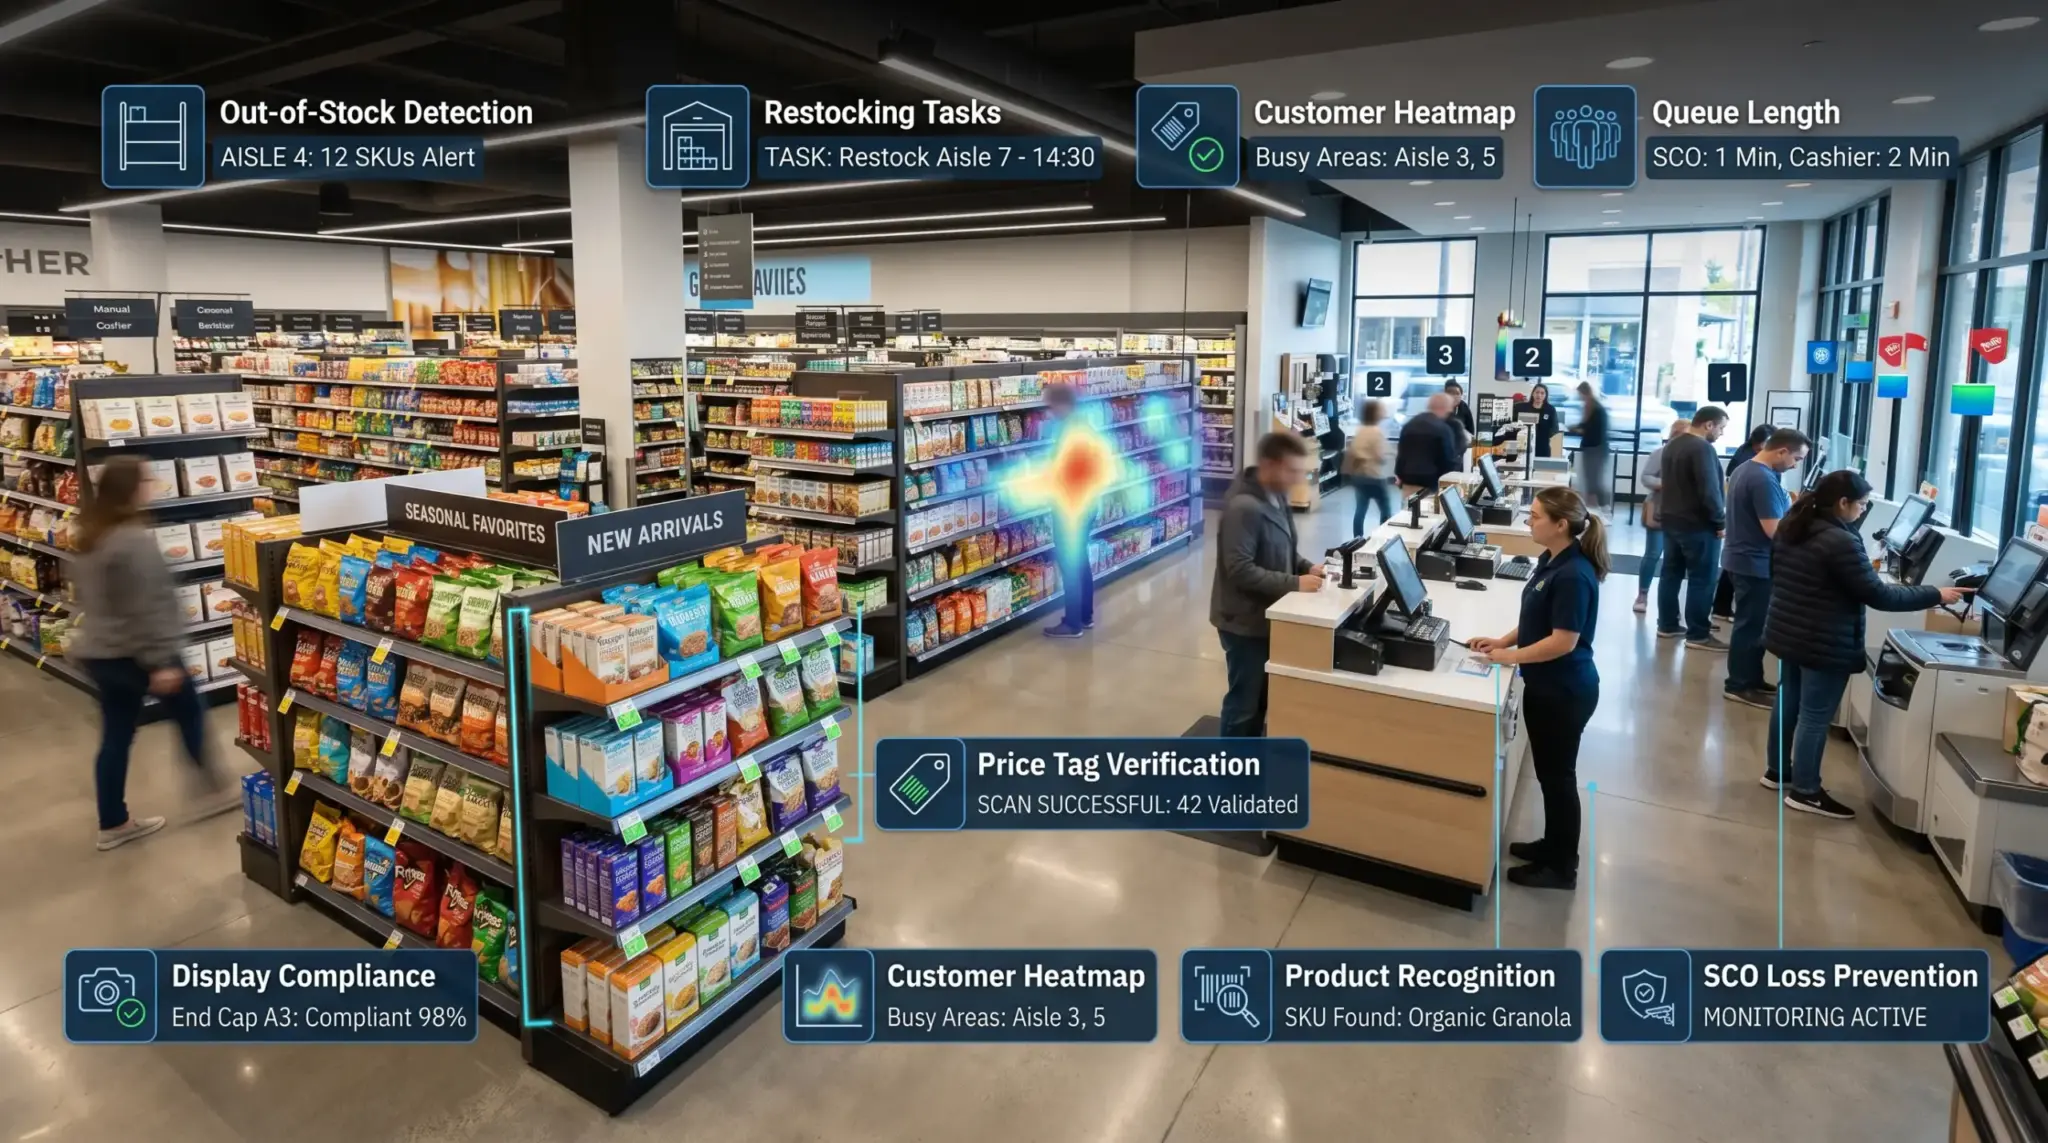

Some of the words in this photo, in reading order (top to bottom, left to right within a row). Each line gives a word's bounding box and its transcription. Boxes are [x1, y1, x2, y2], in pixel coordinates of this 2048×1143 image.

[93, 305, 131, 314] Manual
[405, 502, 470, 531] SEASONAL
[472, 513, 546, 544] FAVORITES
[587, 527, 633, 556] NEW
[637, 510, 724, 546] ARRIVALS
